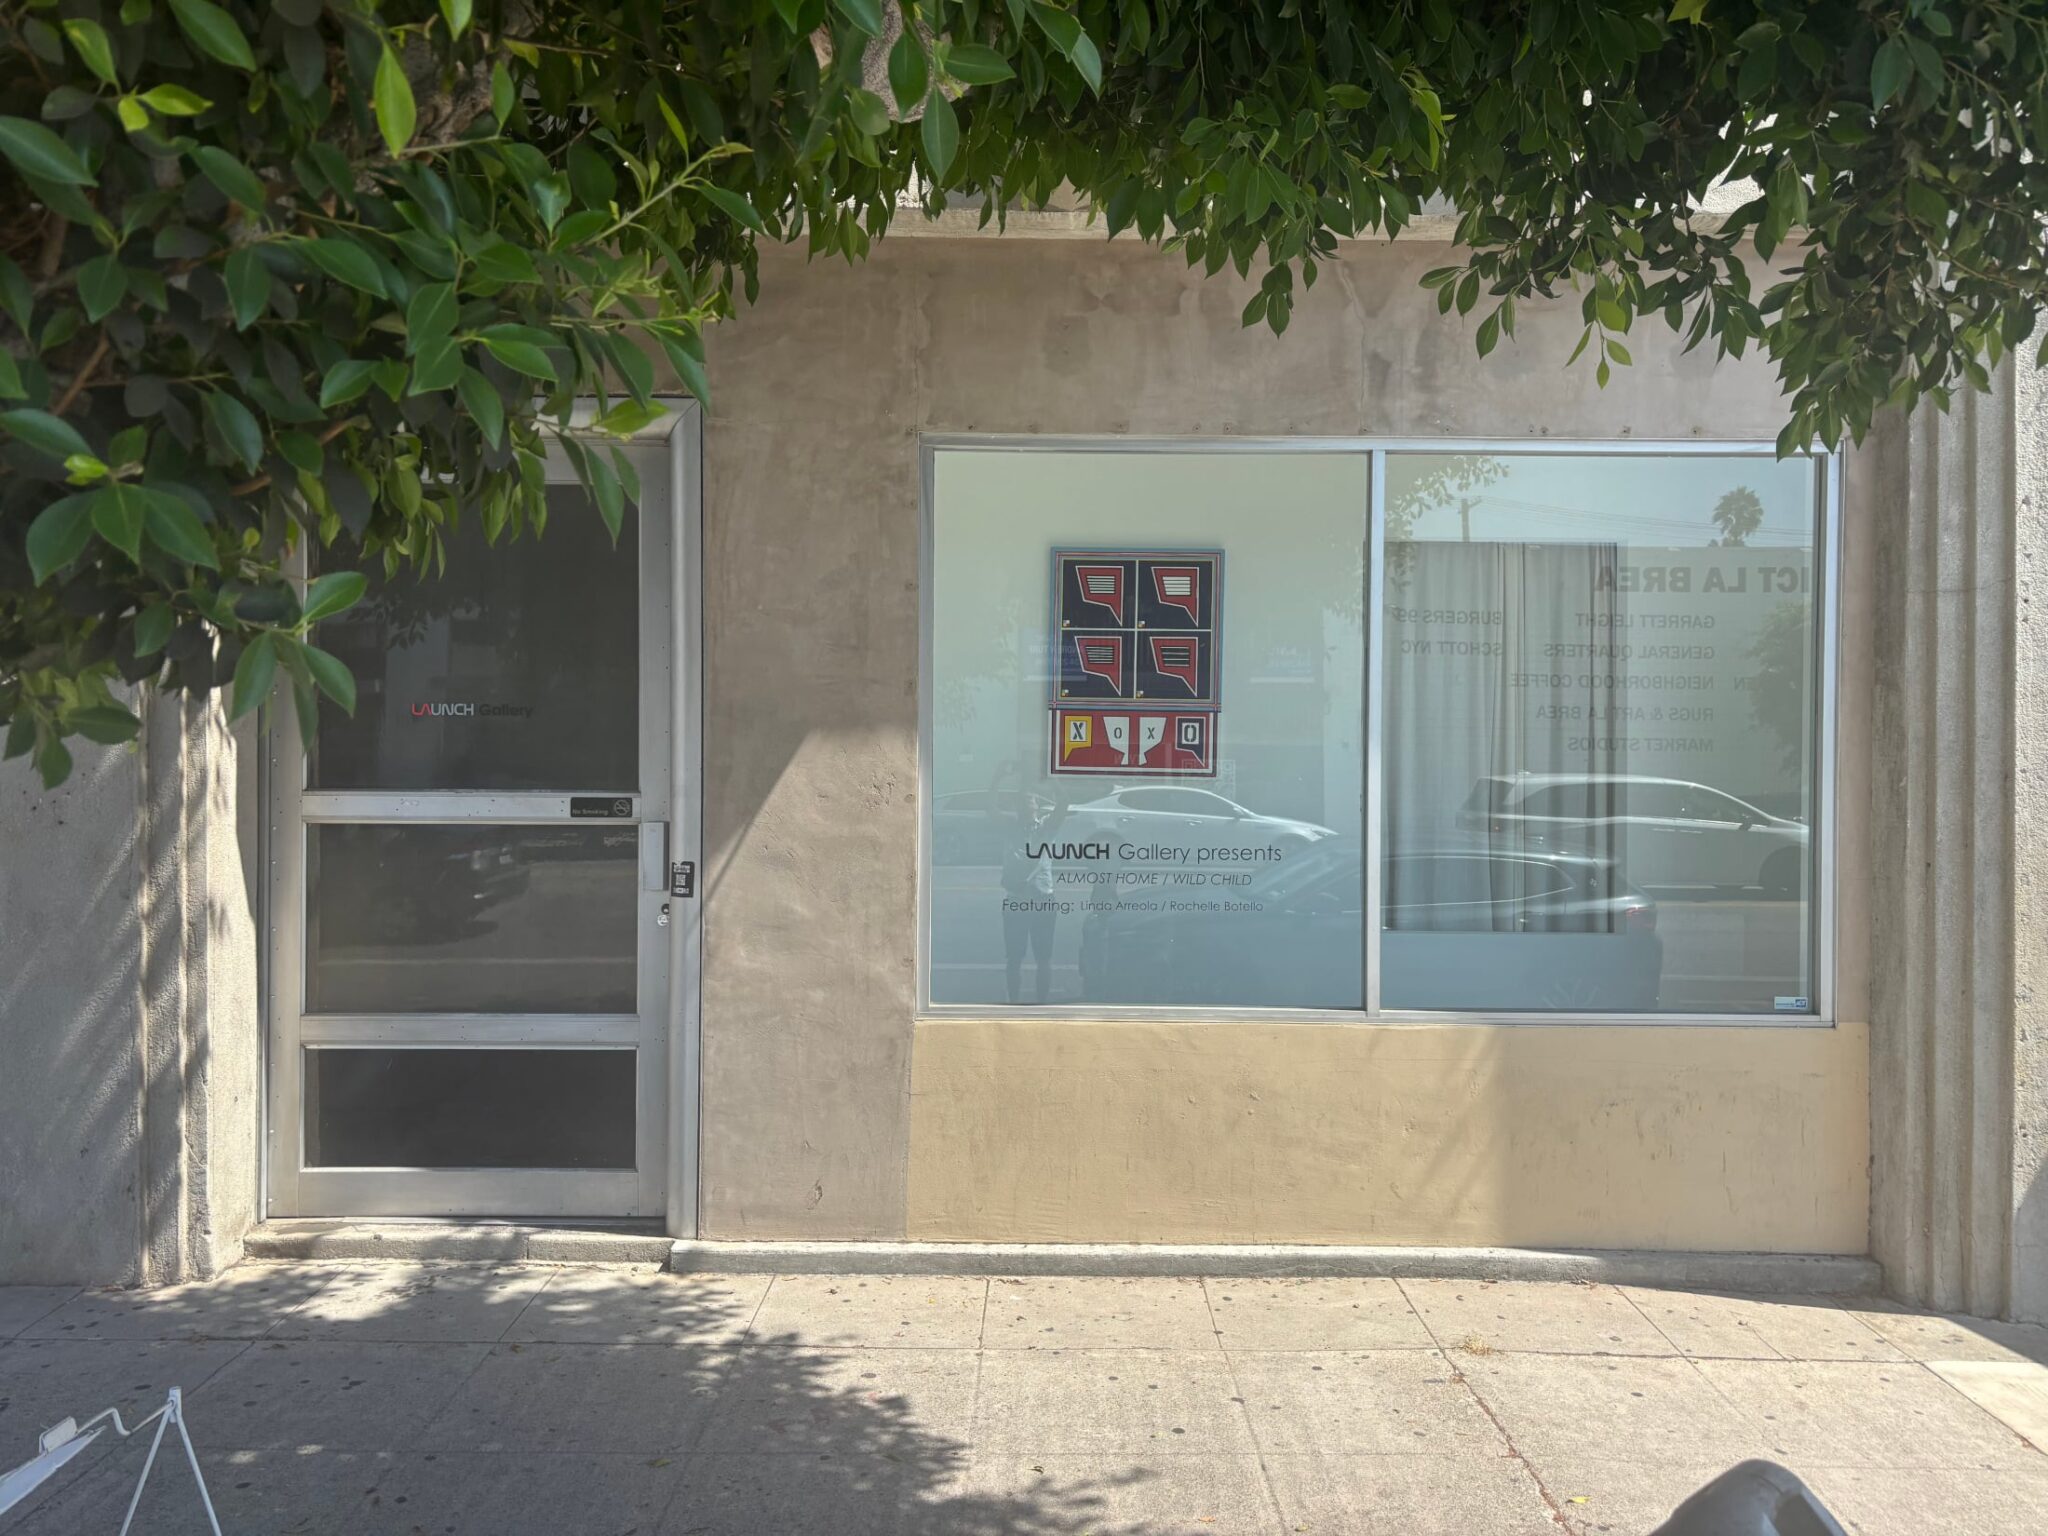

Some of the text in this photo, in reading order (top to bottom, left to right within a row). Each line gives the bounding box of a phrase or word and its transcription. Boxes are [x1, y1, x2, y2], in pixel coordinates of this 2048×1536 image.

[411, 703, 534, 719] LAUNCH Gallery
[1025, 842, 1283, 864] LAUNCH Gallery presents
[1056, 872, 1114, 885] ALMOST
[1115, 873, 1159, 885] HOME
[1172, 873, 1207, 886] WILD
[1210, 874, 1252, 886] CHILD
[1002, 898, 1075, 915] Featuring:
[1080, 899, 1113, 912] Linda
[1115, 900, 1158, 912] Arreola
[1169, 900, 1220, 912] Rochelle
[1224, 900, 1264, 912] Botello
